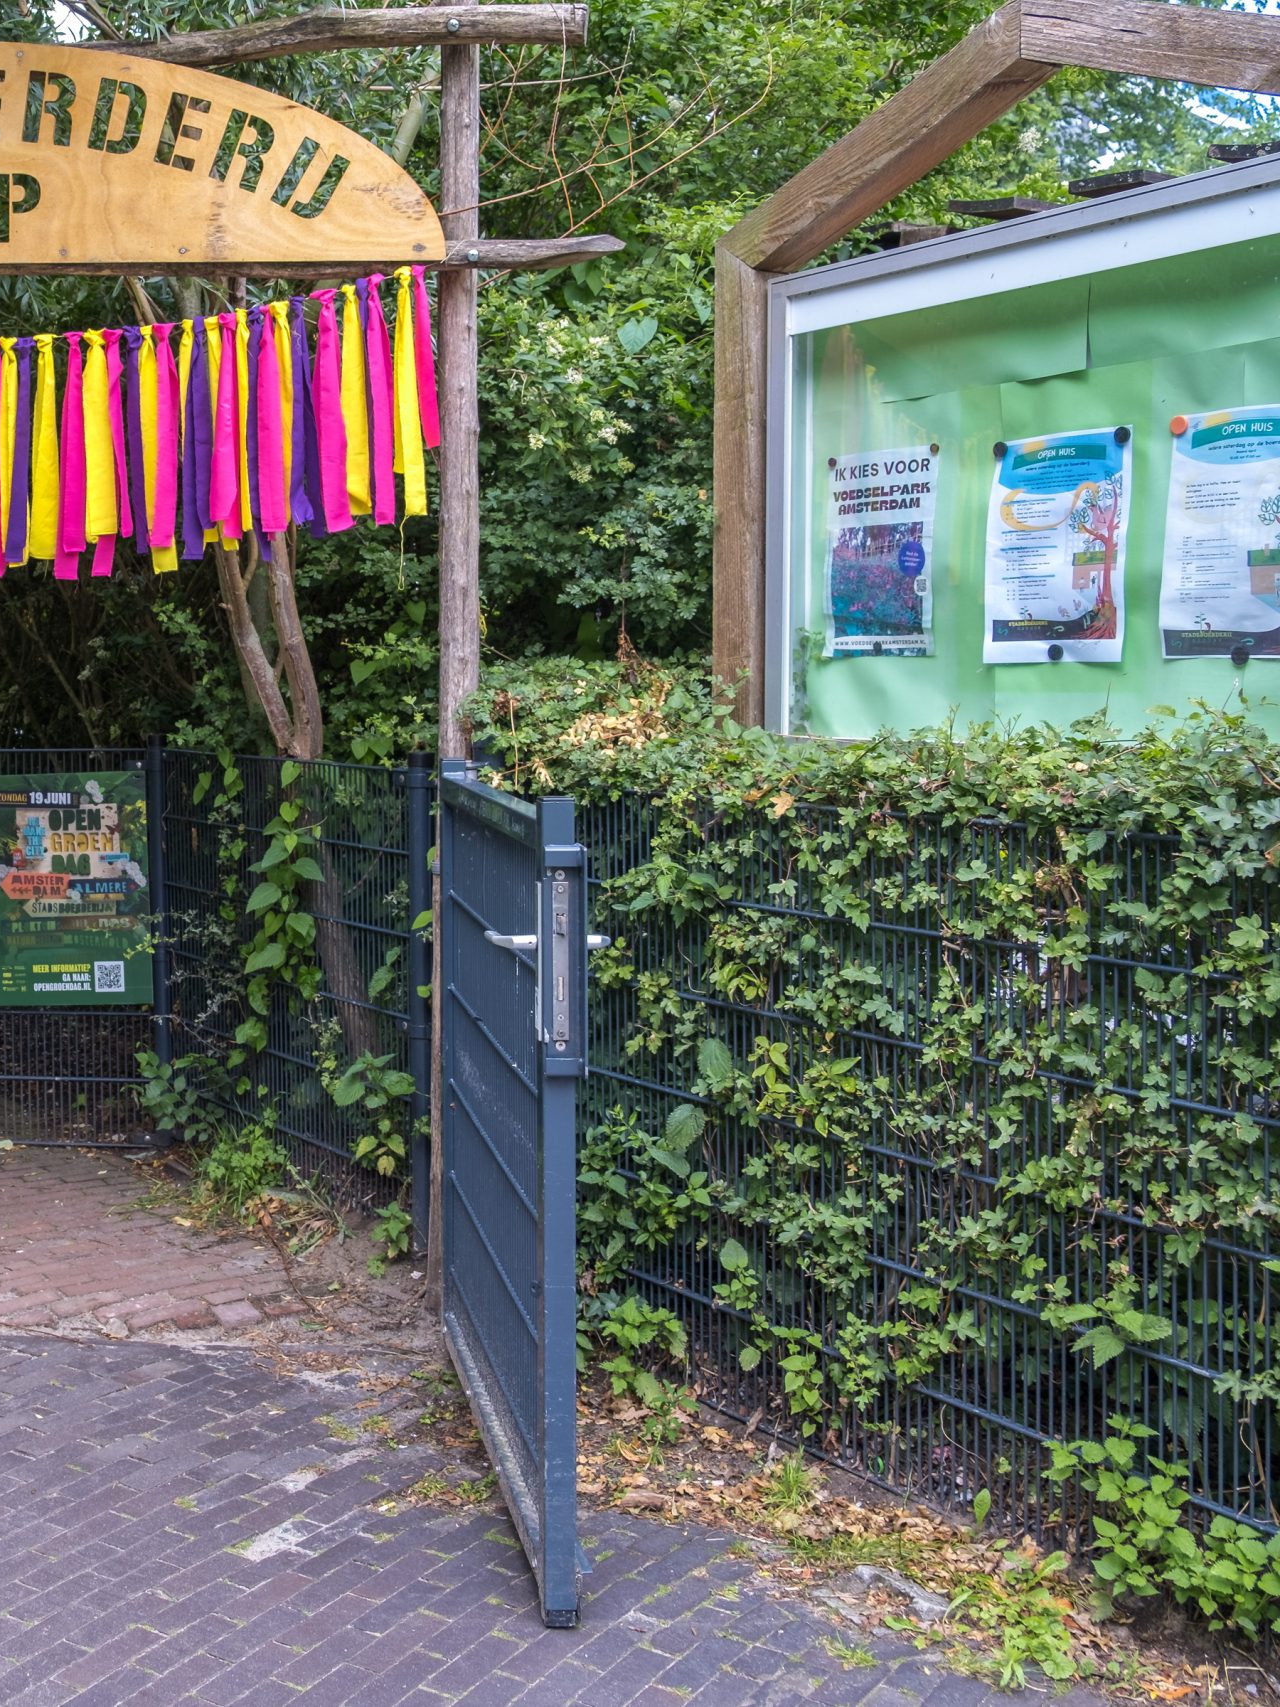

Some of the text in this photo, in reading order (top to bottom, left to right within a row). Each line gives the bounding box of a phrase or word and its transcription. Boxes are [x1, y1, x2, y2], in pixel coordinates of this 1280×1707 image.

[1222, 423, 1273, 435] OPEN HUIS
[1038, 448, 1075, 459] OPEN HUIS
[835, 458, 930, 482] IK KIES VOOR
[833, 482, 931, 502] VOEDSELPARK
[838, 497, 920, 515] AMSTERDAM
[29, 792, 43, 803] 19
[44, 792, 71, 804] JUNI
[48, 809, 101, 831] OPEN
[50, 832, 113, 852] GROEN
[51, 854, 90, 875] DAG
[12, 875, 64, 885] AMSTER
[33, 887, 61, 895] DAM
[51, 964, 91, 972] INFORMATIE?
[34, 983, 91, 991] OPENGROENDAG.NL
